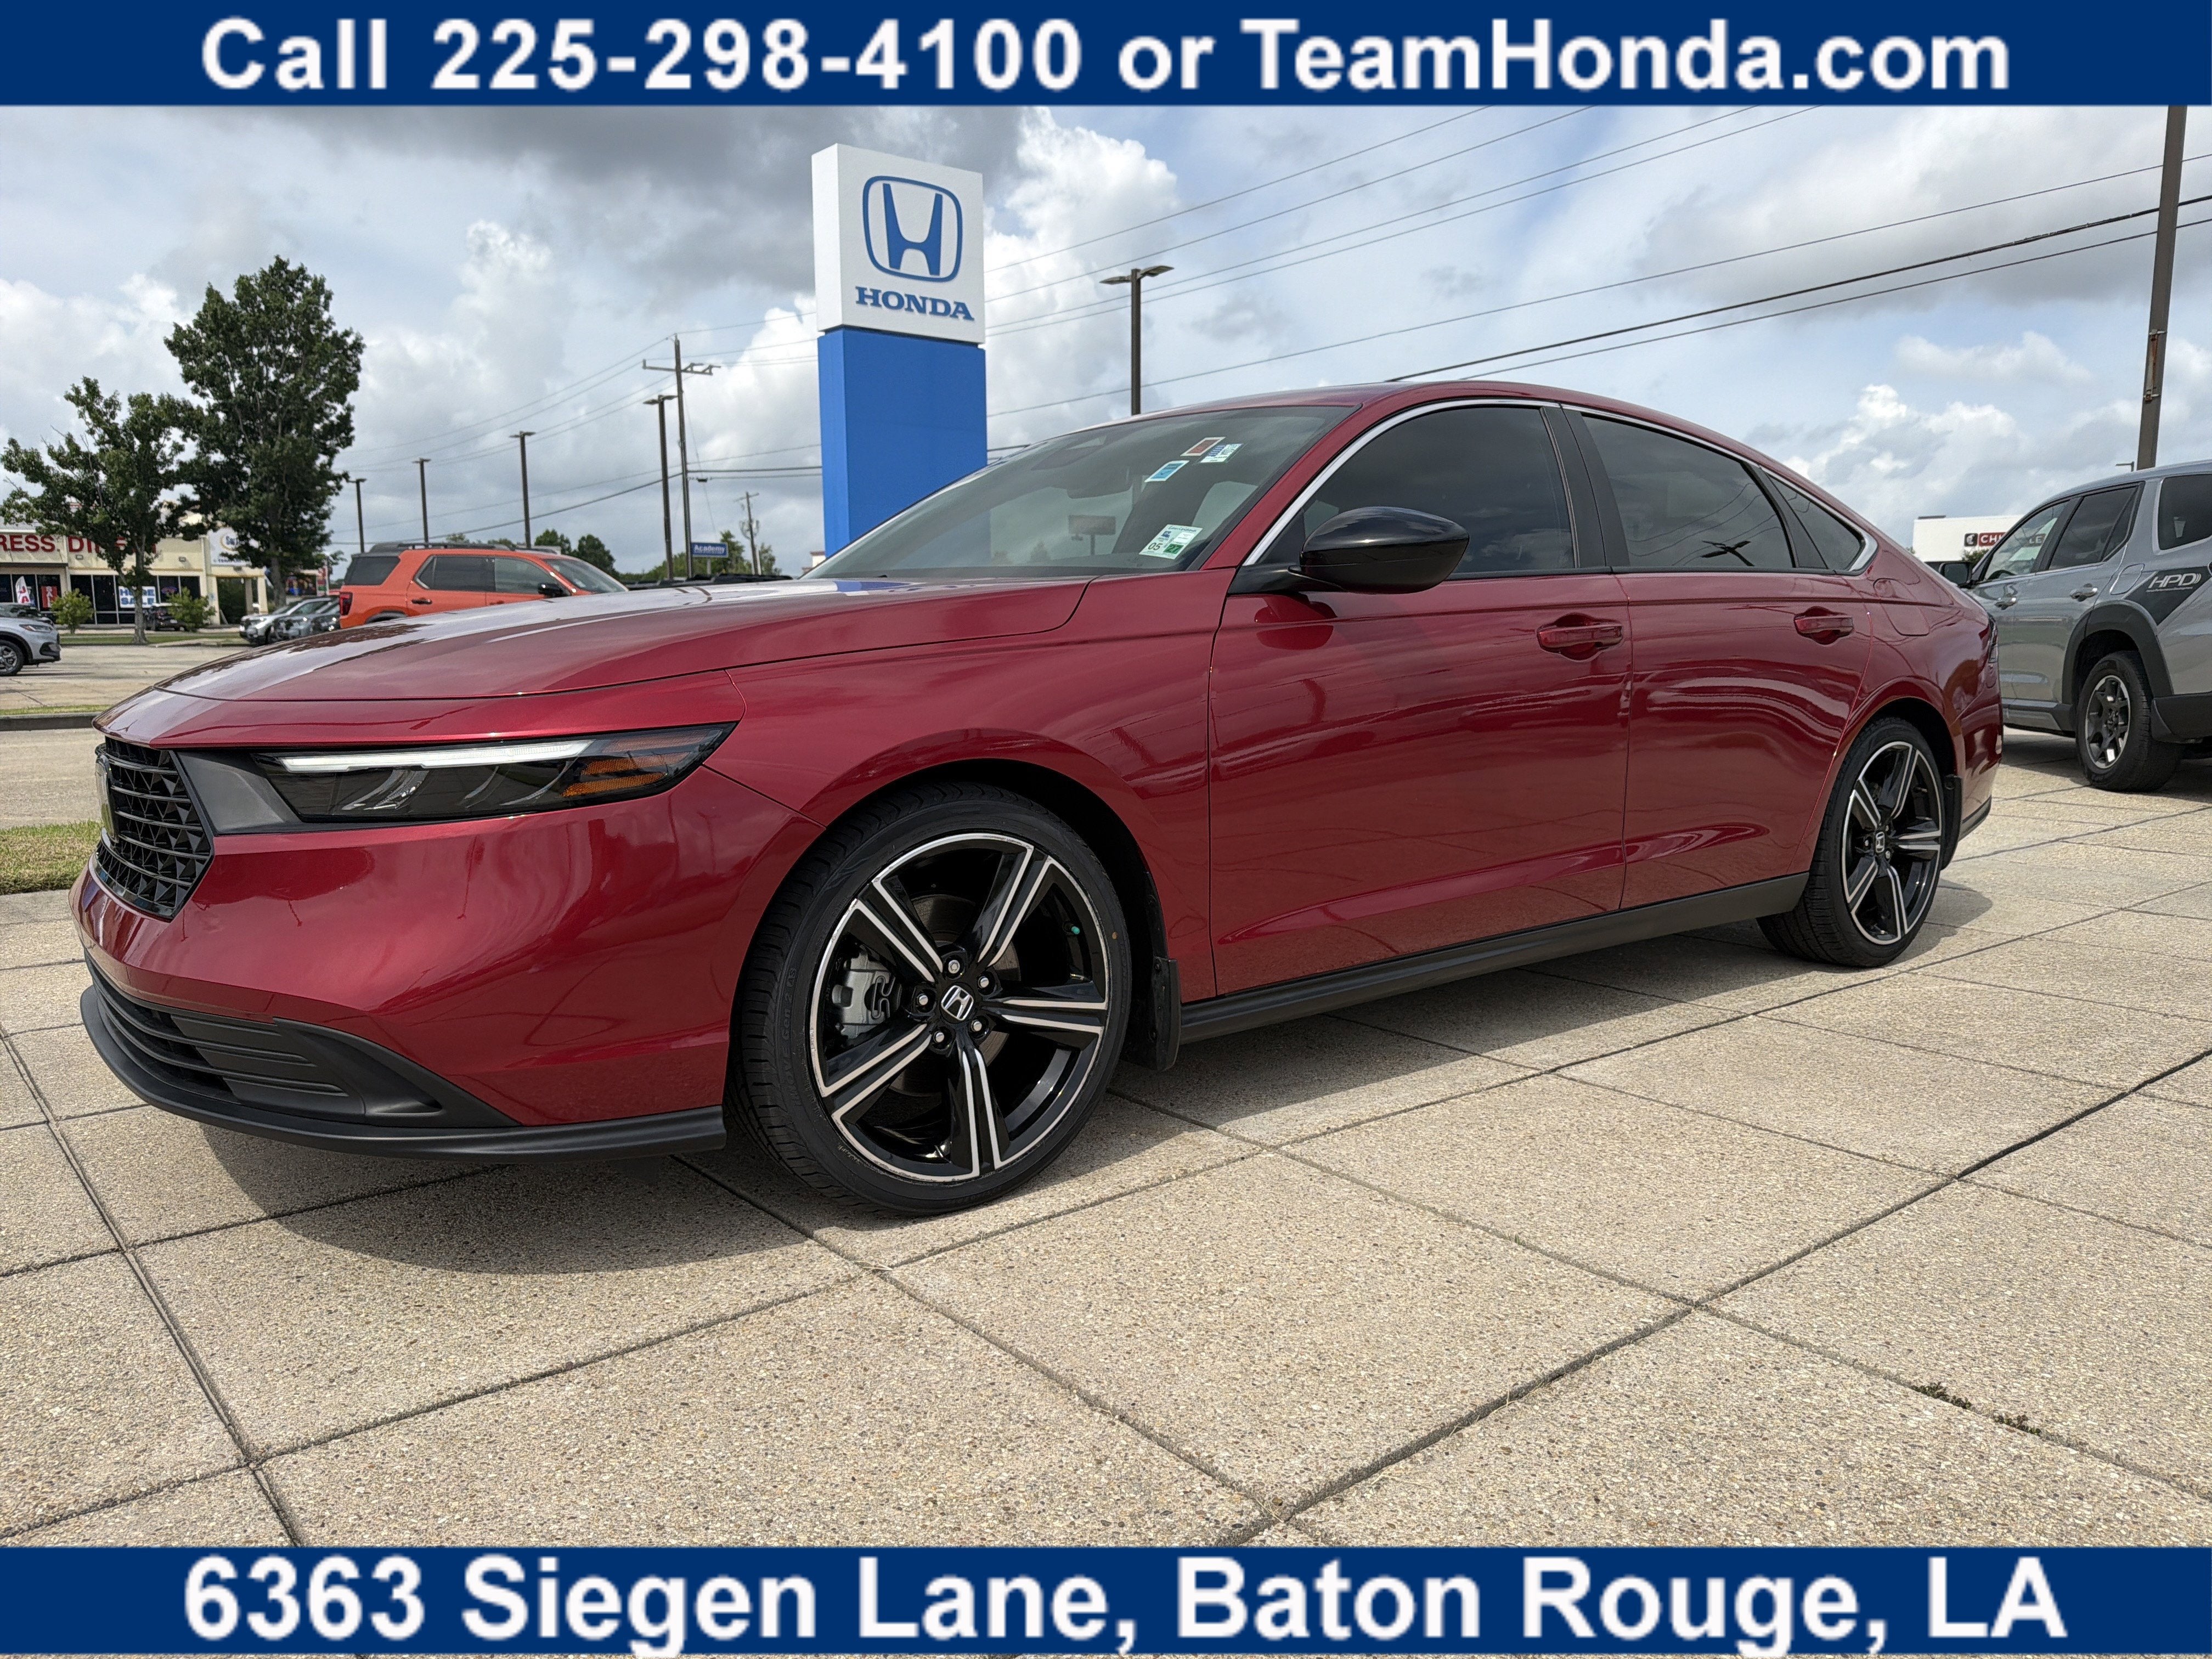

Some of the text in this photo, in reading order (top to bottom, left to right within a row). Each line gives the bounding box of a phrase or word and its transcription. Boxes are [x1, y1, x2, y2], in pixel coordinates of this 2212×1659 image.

[855, 286, 975, 321] HONDA
[1148, 542, 1164, 551] 05
[2148, 573, 2199, 589] HPD
